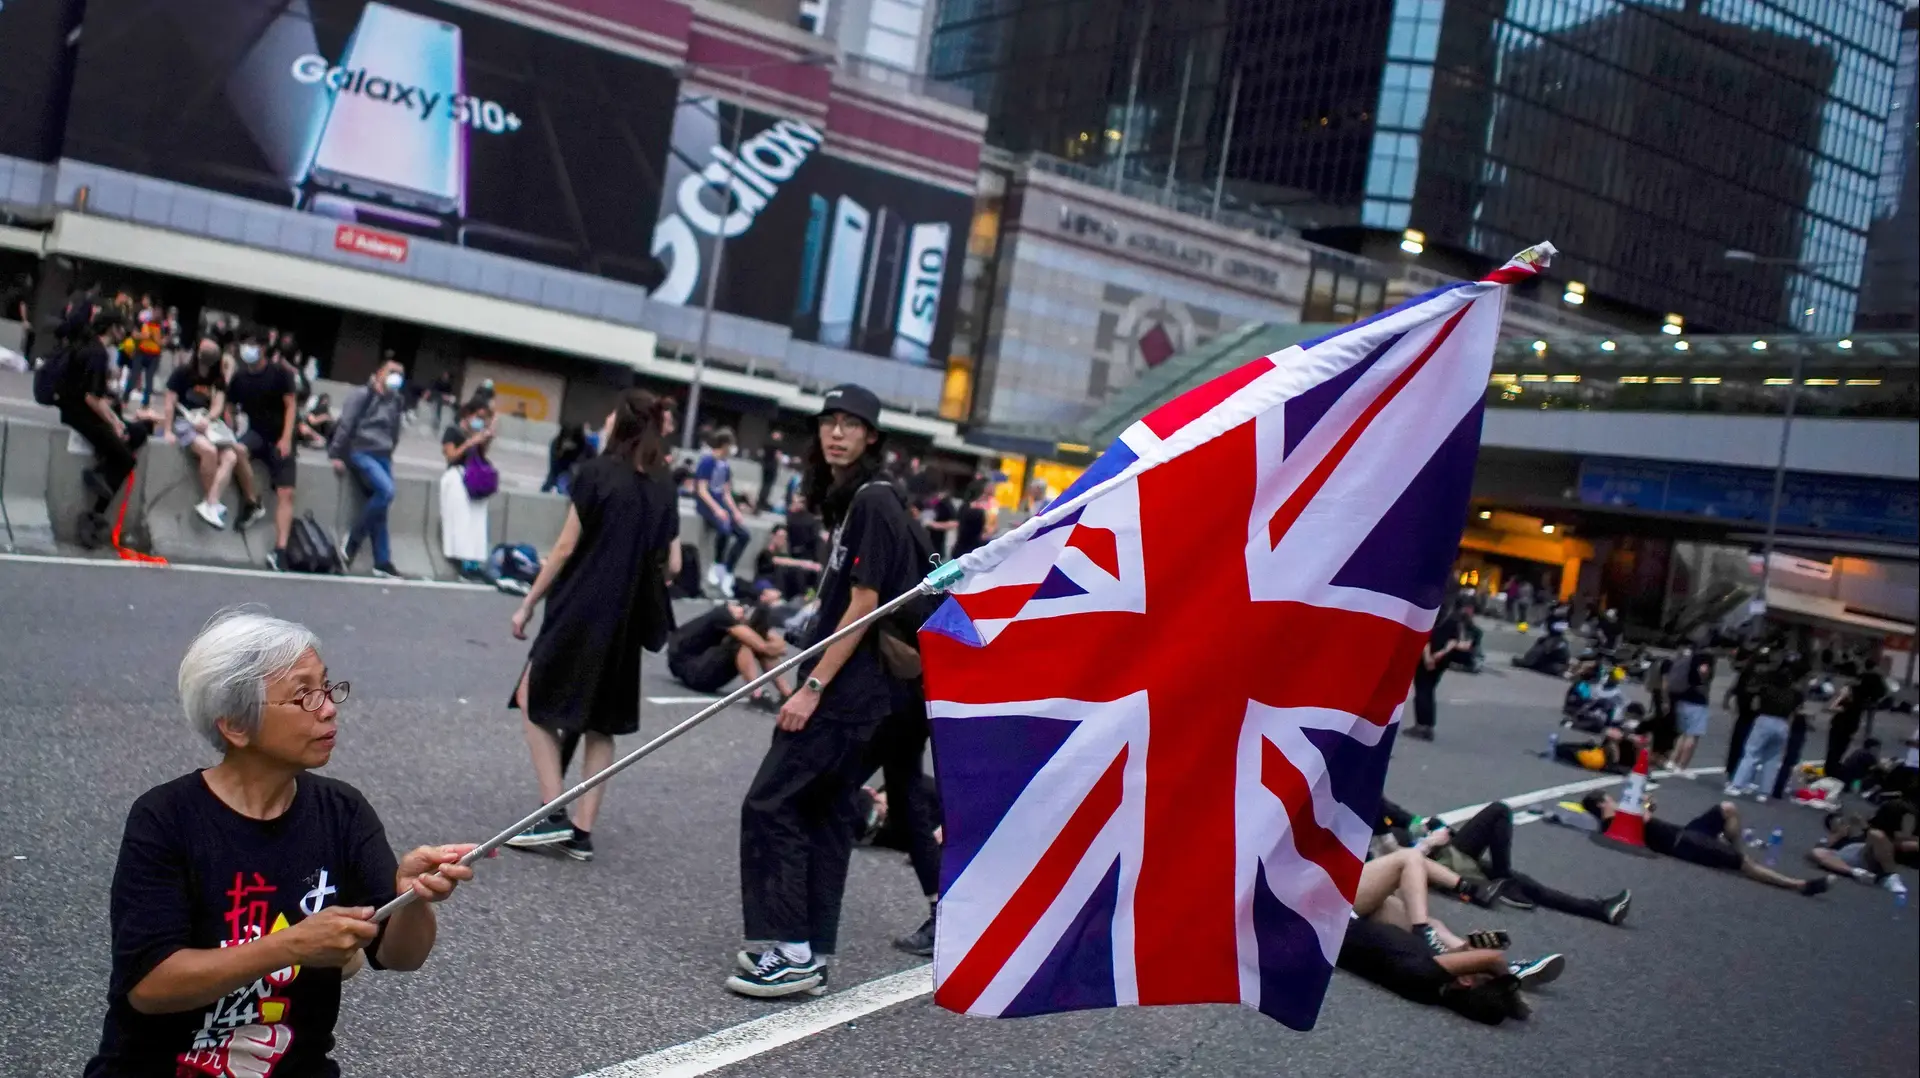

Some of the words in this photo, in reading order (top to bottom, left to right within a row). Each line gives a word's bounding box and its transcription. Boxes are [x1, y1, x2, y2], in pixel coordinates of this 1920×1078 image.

[291, 53, 440, 121] Galaxy
[446, 93, 522, 133] S10+
[911, 247, 943, 323] S10
